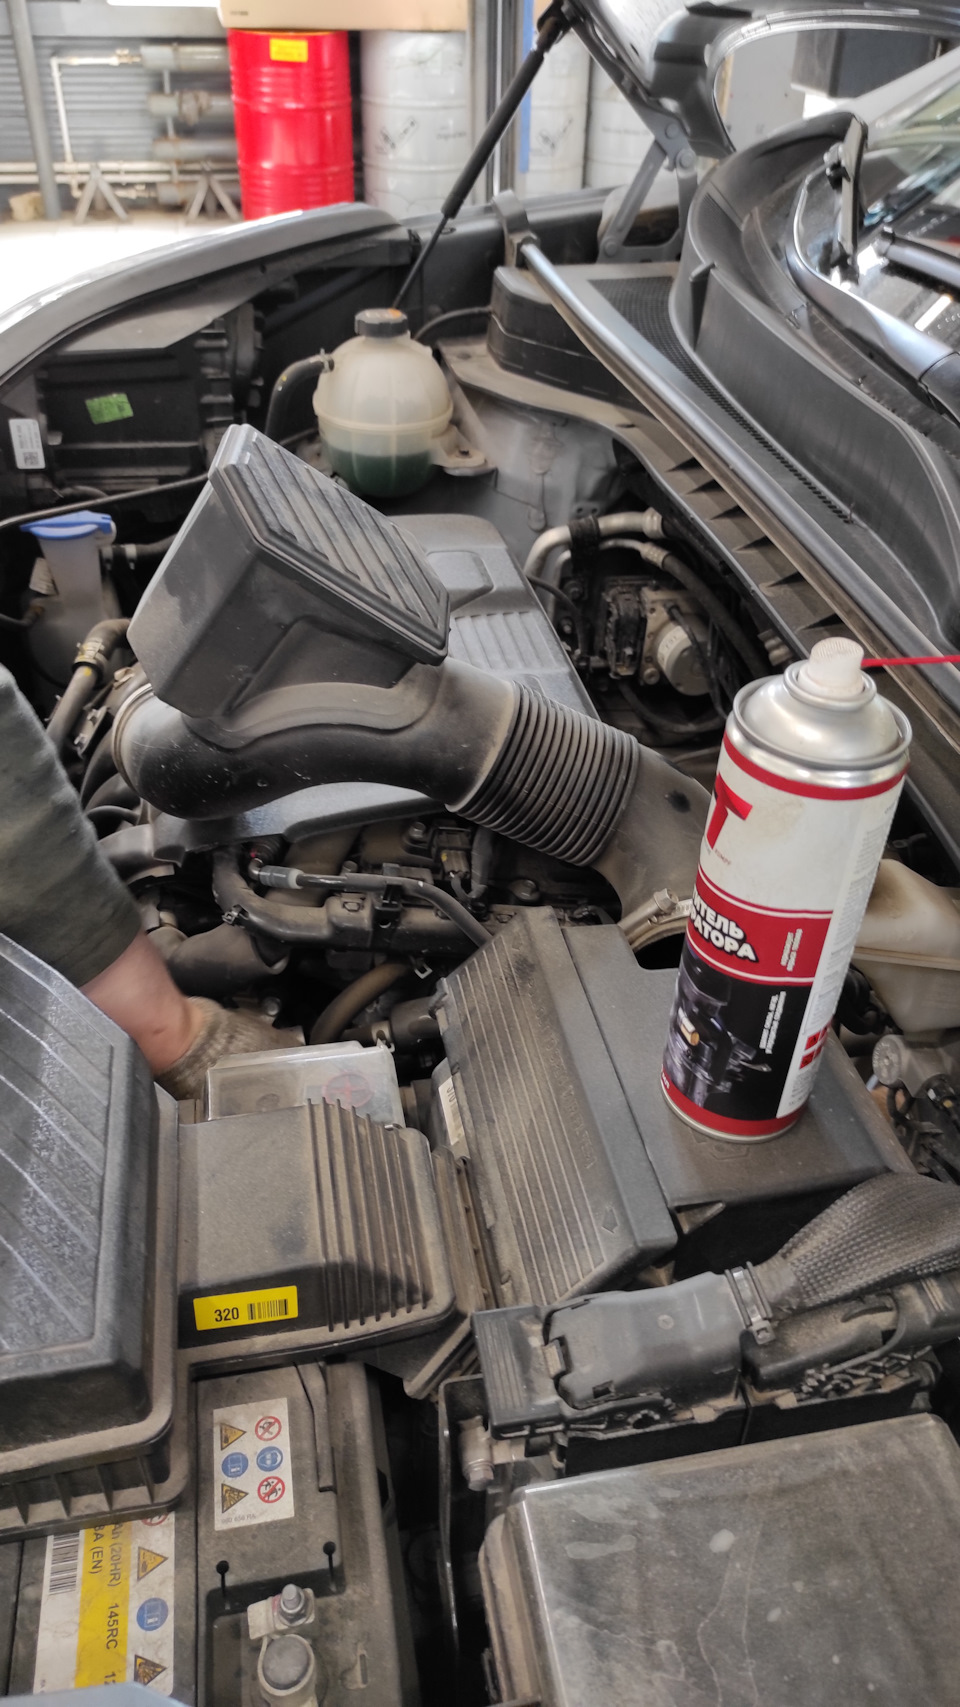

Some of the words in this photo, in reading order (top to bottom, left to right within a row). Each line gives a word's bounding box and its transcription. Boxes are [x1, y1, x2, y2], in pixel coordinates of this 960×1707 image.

[214, 1307, 240, 1322] 320
[88, 1546, 103, 1574] (EN)
[107, 1543, 122, 1586] (20HR)
[106, 1603, 119, 1650] 145RC
